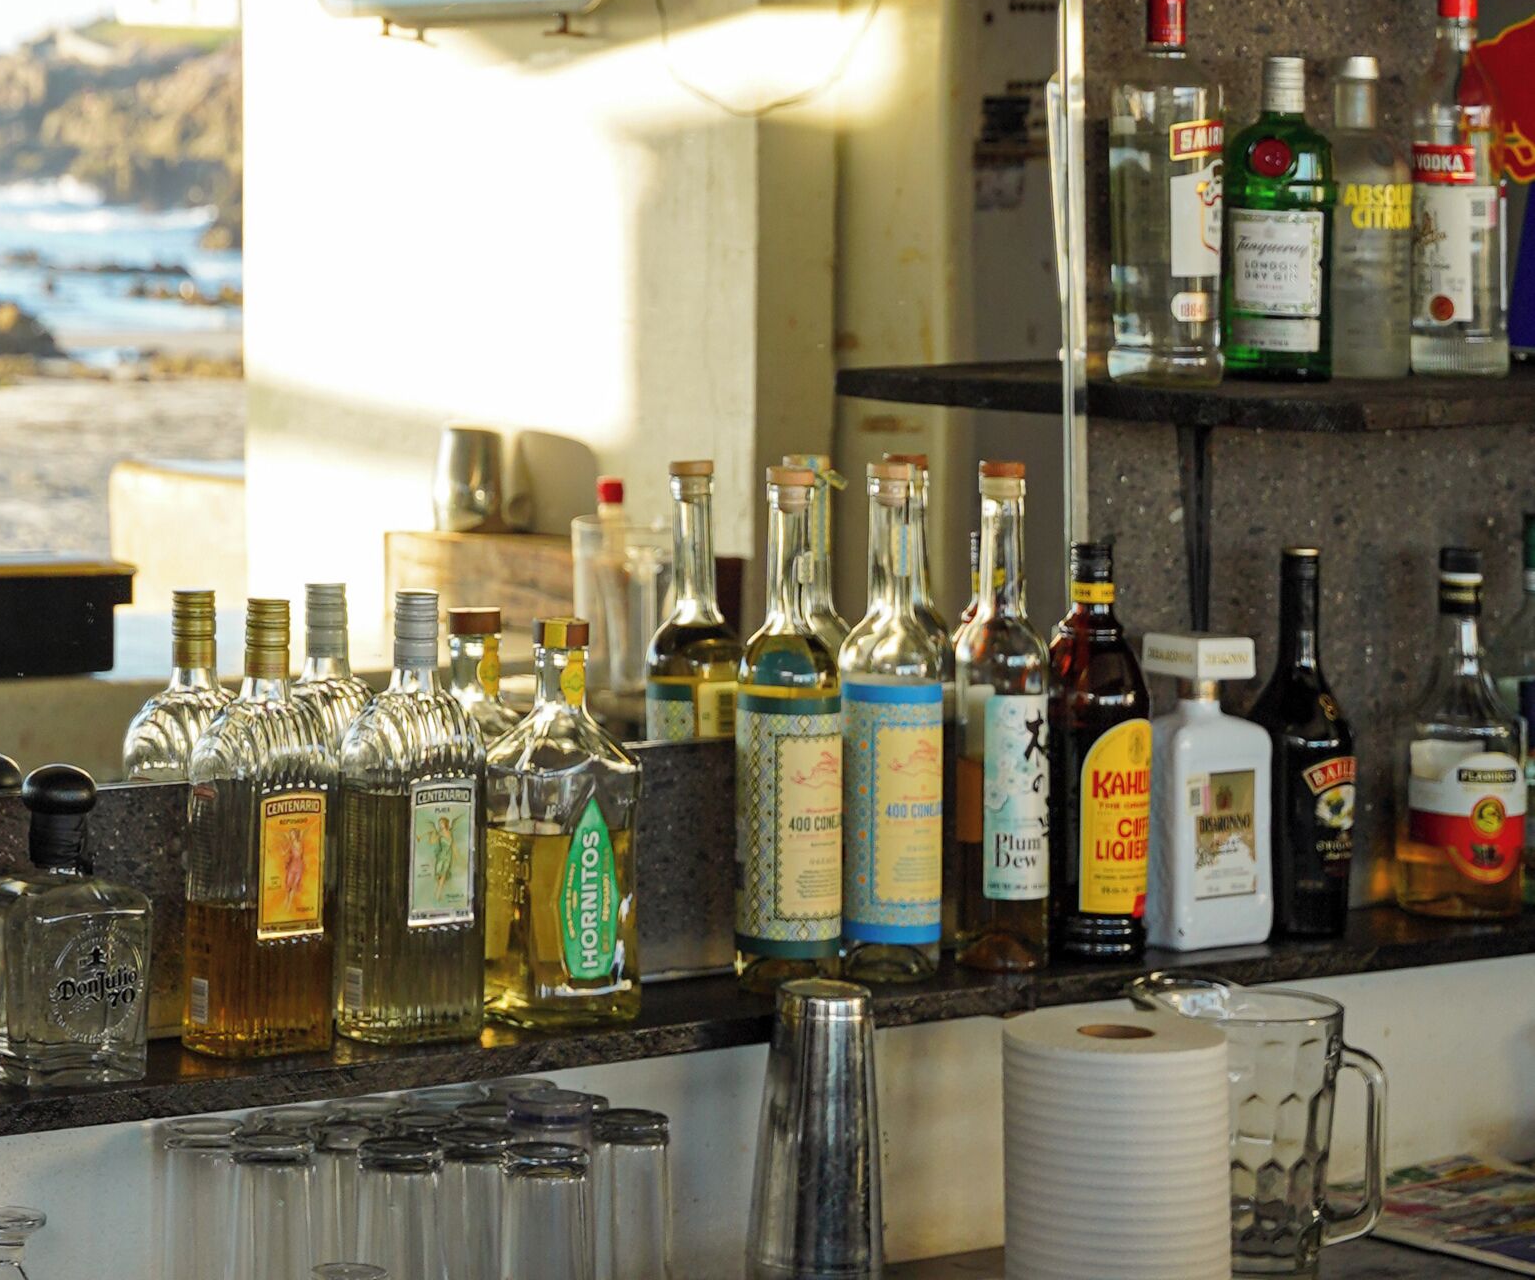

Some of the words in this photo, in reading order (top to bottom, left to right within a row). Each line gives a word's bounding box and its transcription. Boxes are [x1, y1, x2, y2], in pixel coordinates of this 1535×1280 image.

[1416, 154, 1464, 172] VODKA
[1244, 262, 1299, 271] LONDON
[1244, 271, 1267, 281] DRY
[1273, 271, 1299, 281] GIN
[417, 790, 470, 805] CENTENARIO
[267, 799, 320, 816] CENTENARIO
[886, 803, 908, 818] 400
[788, 816, 811, 831] 400
[995, 832, 1041, 851] Plum
[994, 849, 1039, 869] Dew
[580, 830, 601, 968] HORNITOS
[108, 986, 136, 1008] 70
